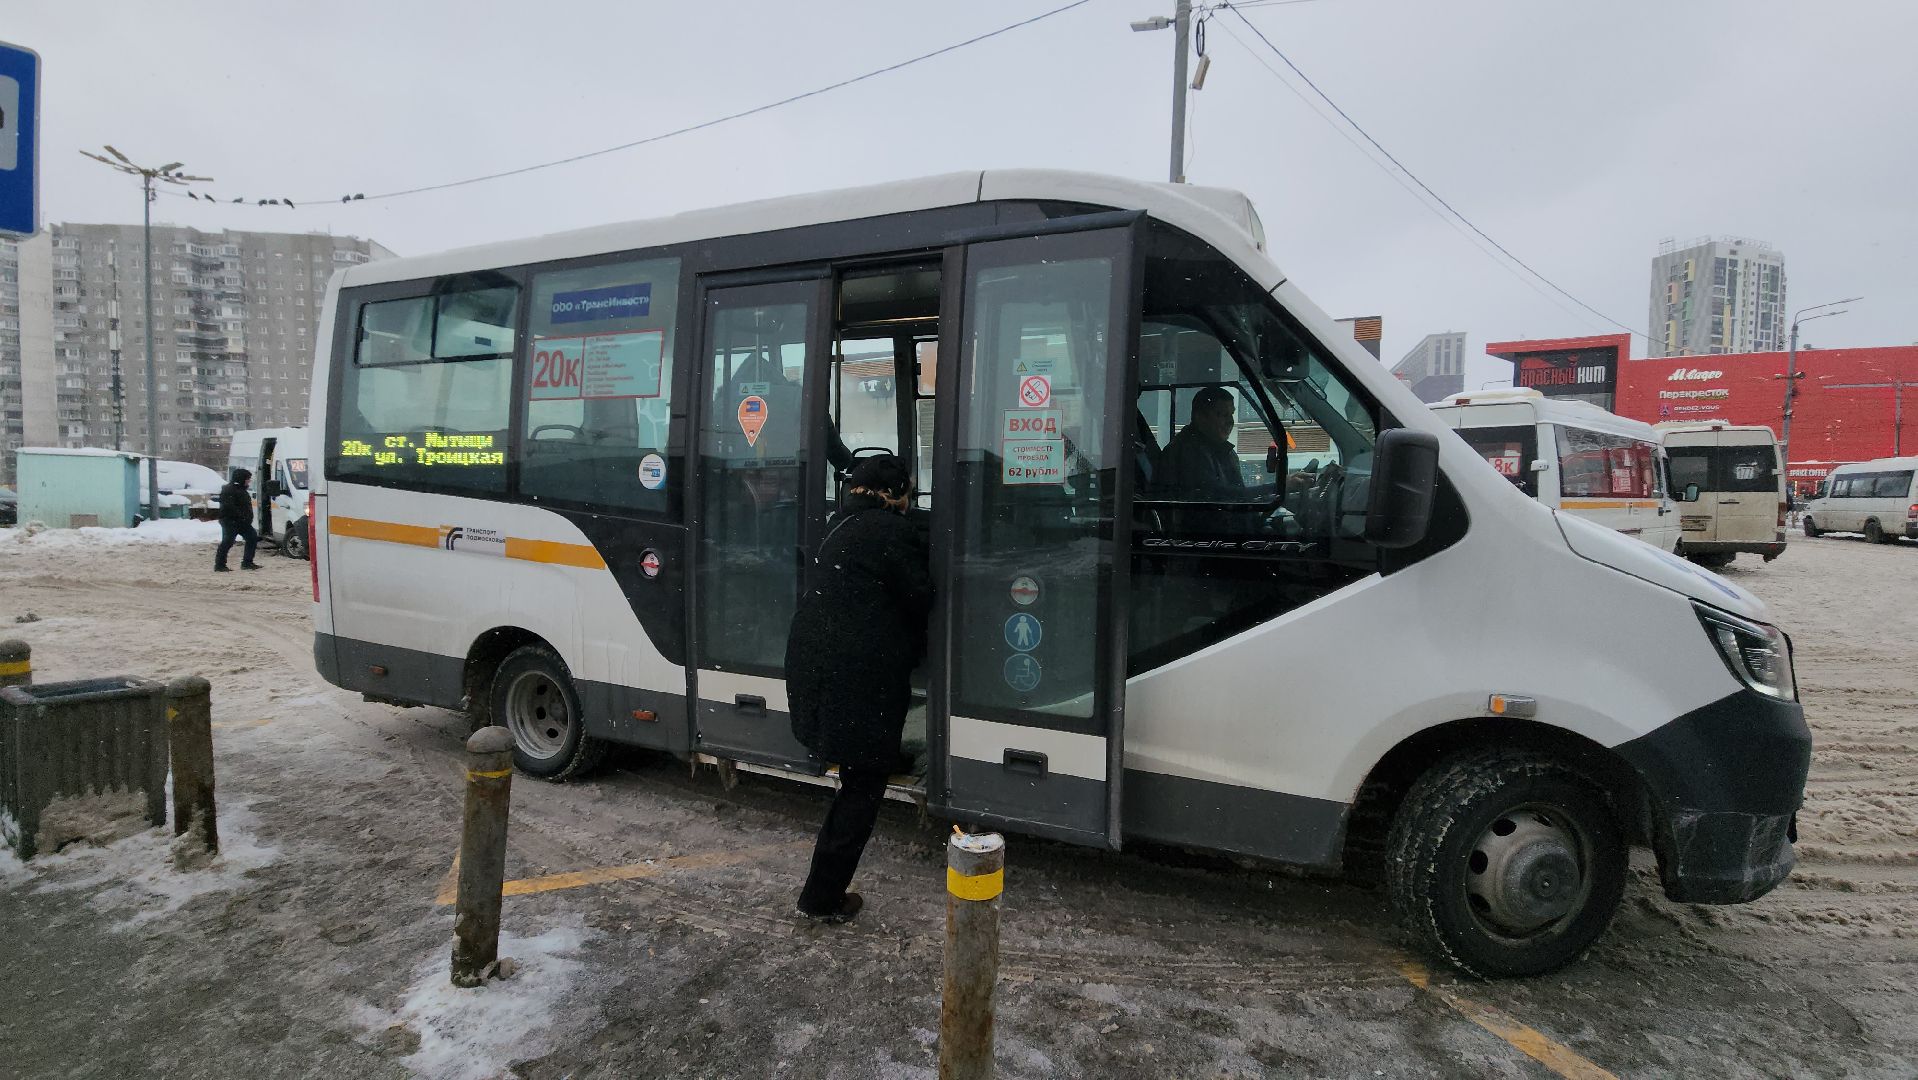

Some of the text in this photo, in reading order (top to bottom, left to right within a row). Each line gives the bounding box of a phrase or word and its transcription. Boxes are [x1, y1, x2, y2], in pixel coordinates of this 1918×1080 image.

[1008, 417, 1057, 434] ВХОД
[384, 432, 493, 449] ст. Мытищи
[374, 447, 504, 466] ул. Троицкая
[1008, 467, 1023, 477] 62
[466, 527, 497, 535] ТРАНСПОРТ
